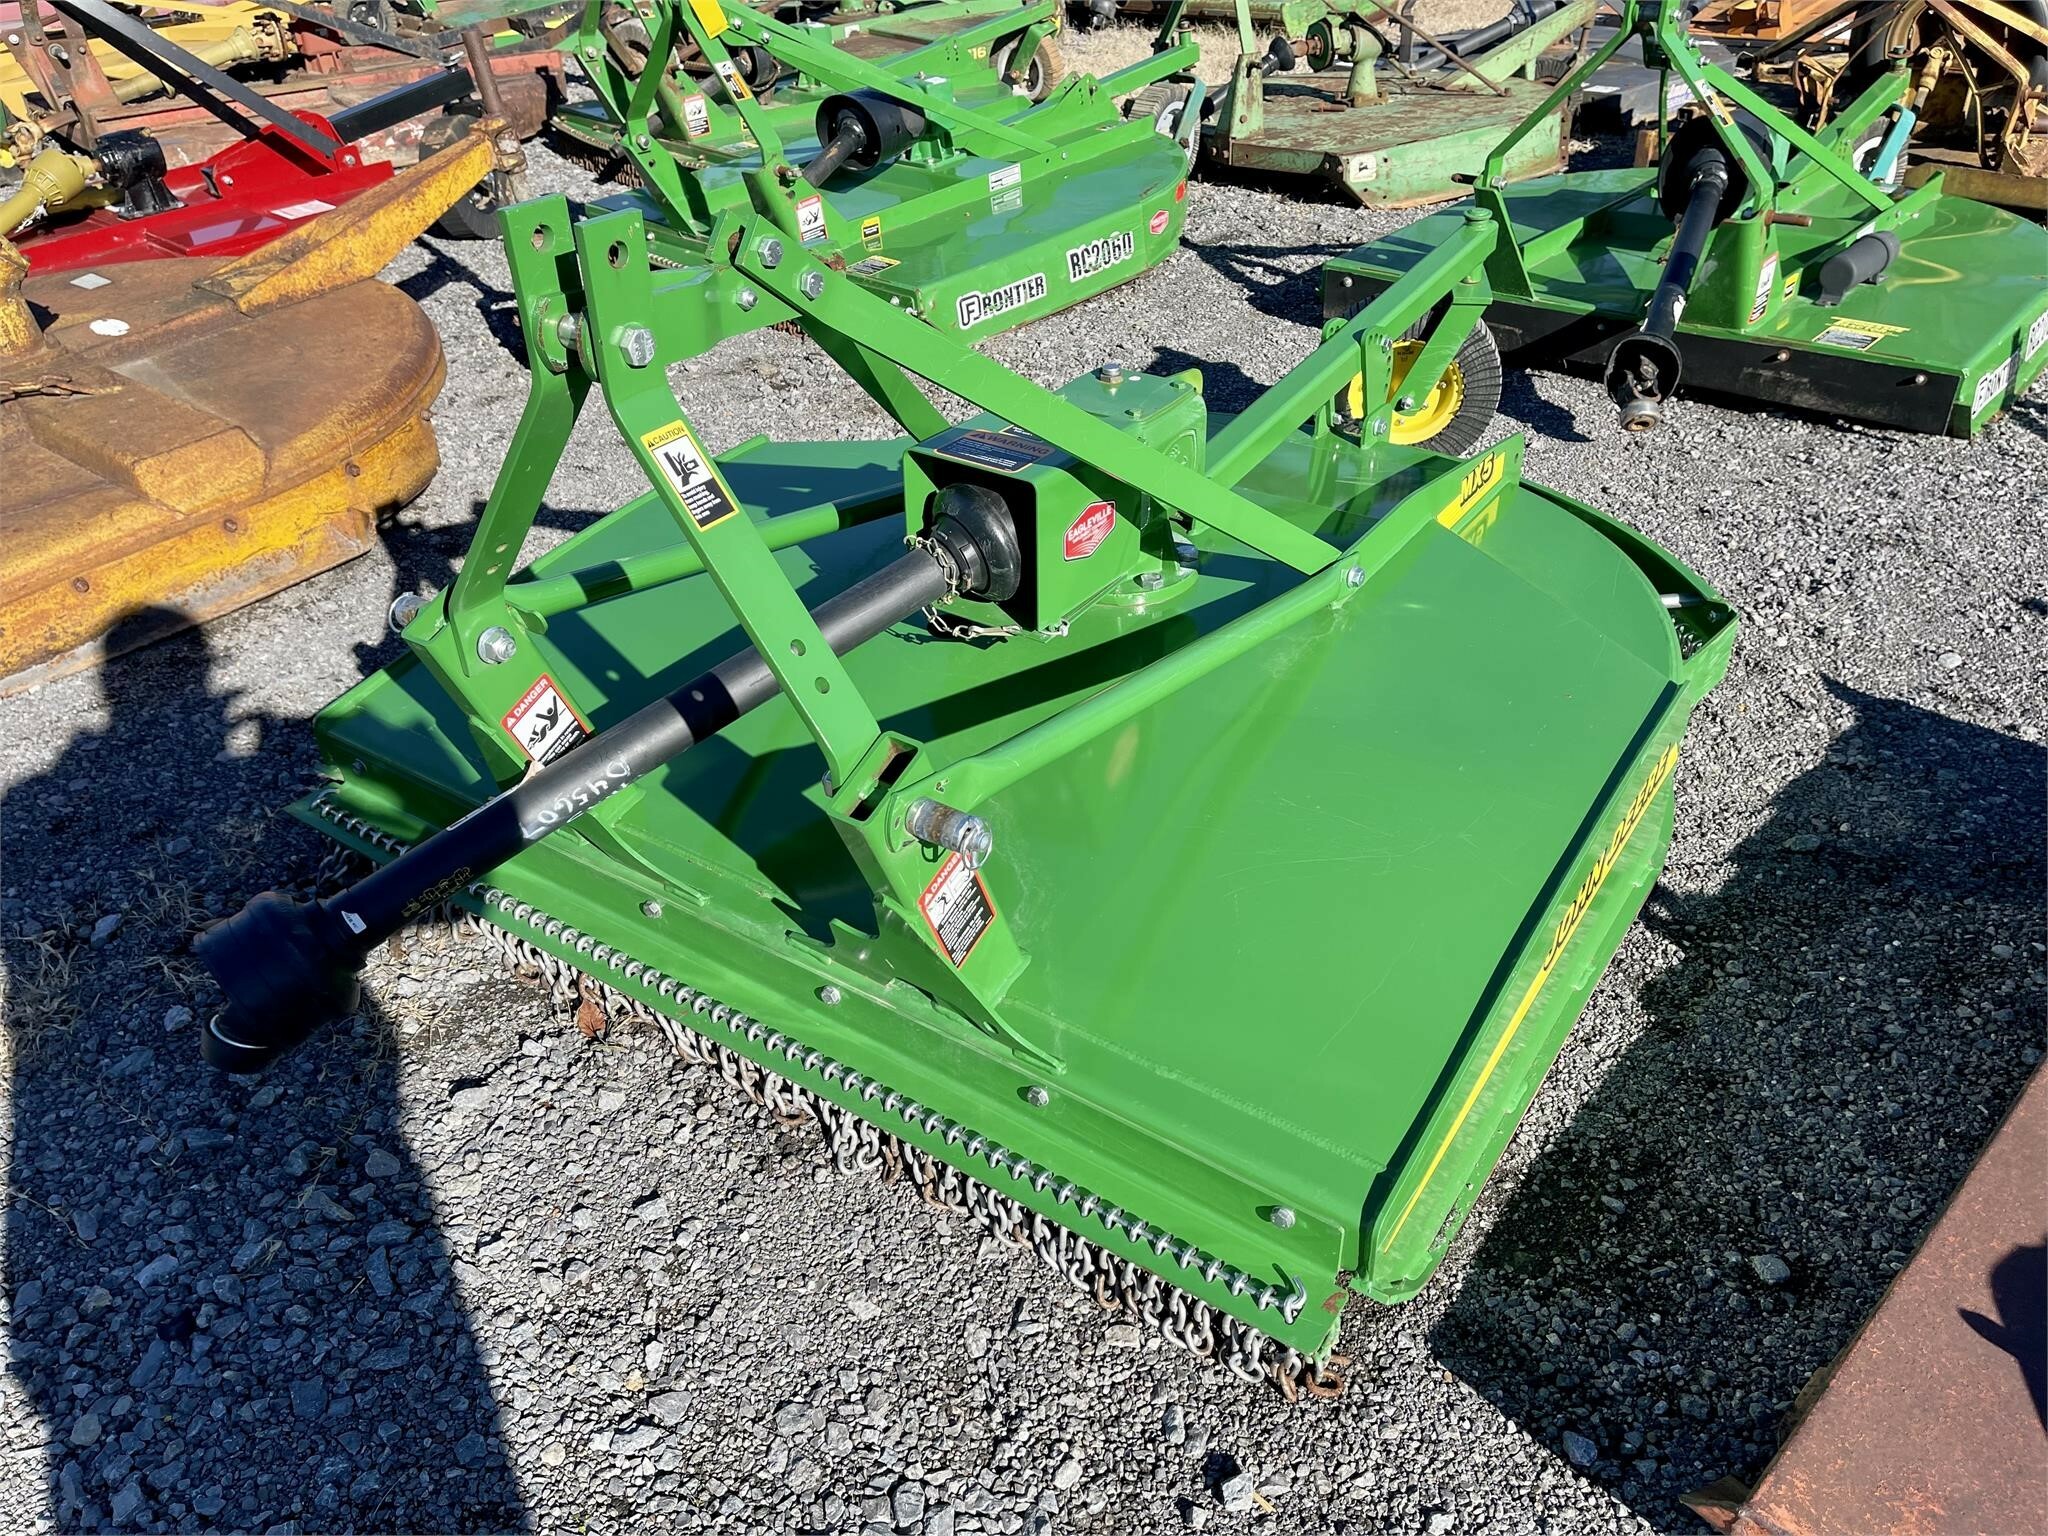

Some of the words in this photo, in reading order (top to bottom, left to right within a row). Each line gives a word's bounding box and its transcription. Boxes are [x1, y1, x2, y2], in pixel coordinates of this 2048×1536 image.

[1070, 231, 1133, 279] RC2060
[960, 275, 1045, 326] FRONTIER
[652, 425, 686, 446] CAUTION
[986, 433, 1051, 455] WARNING
[1460, 451, 1495, 507] MX5
[1067, 504, 1113, 542] EAGLEVILLE
[513, 678, 548, 717] DANGER
[930, 852, 962, 893] DANGE
[1543, 846, 1608, 972] JOHN
[1606, 742, 1673, 867] DEERE
